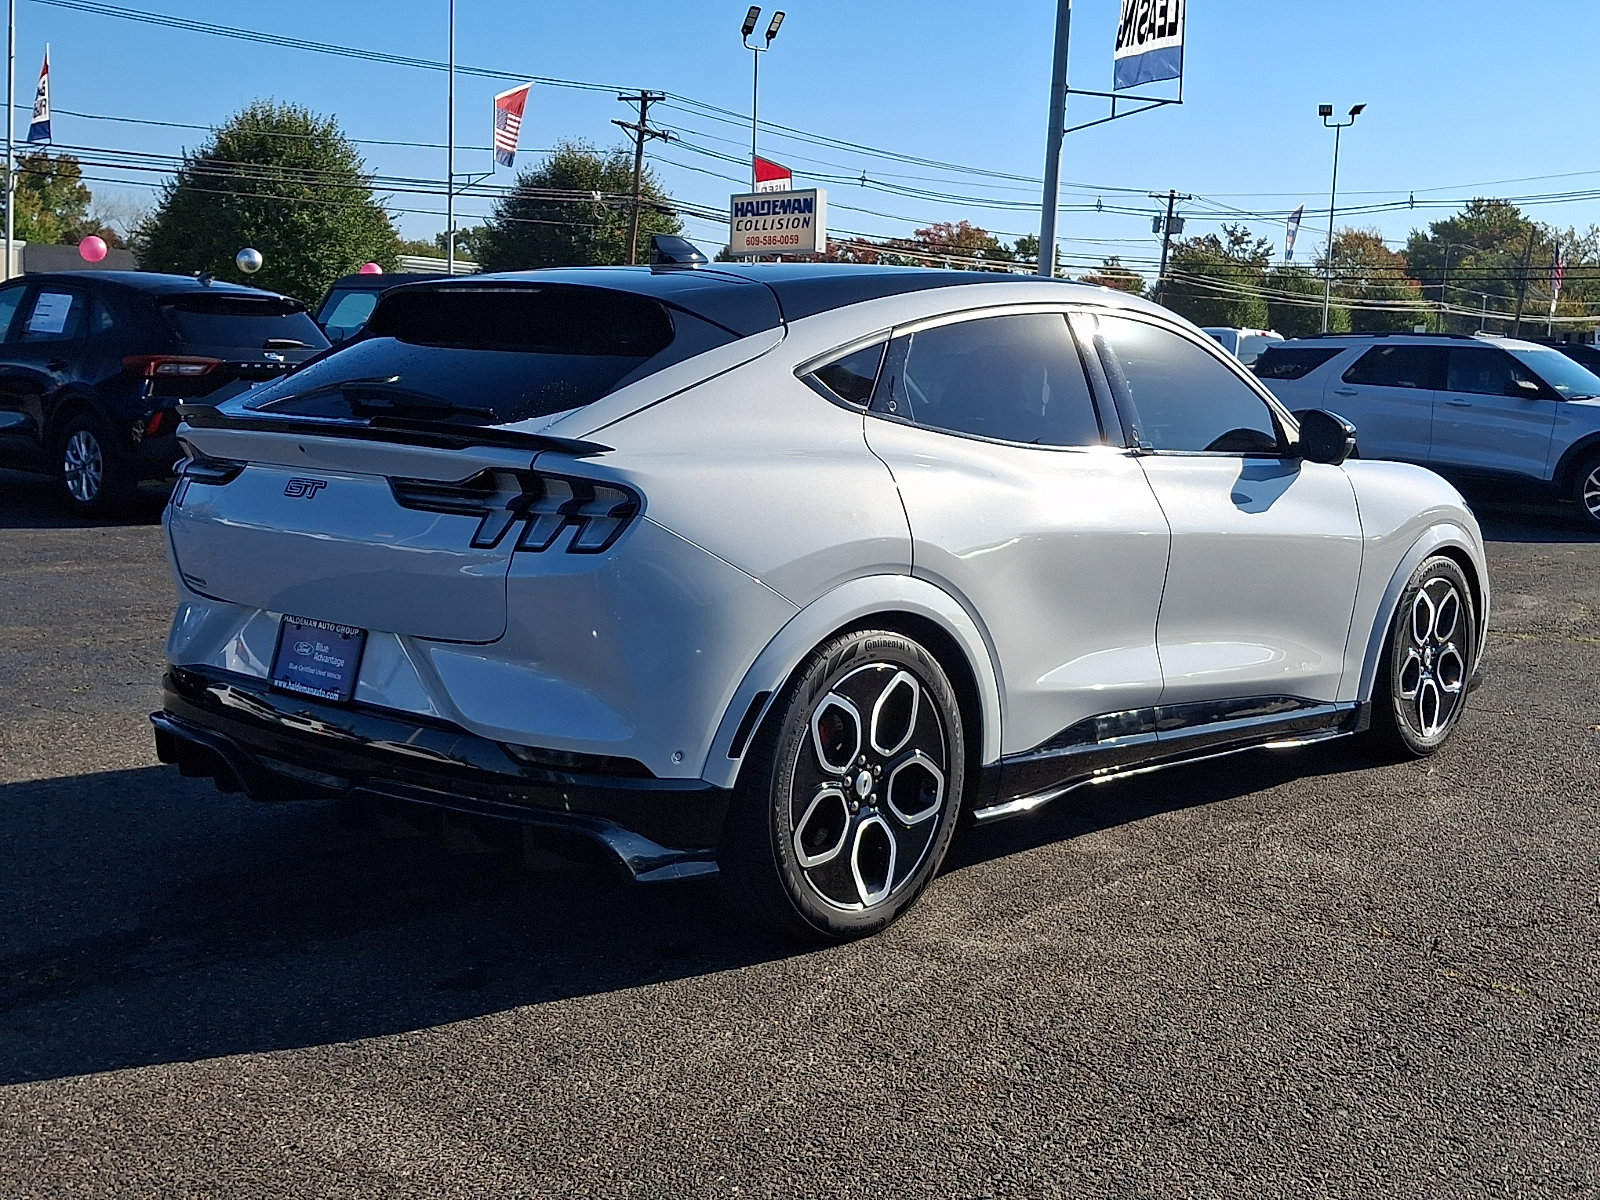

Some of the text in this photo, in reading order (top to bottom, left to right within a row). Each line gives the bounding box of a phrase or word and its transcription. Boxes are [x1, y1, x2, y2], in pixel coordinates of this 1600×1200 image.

[734, 197, 813, 217] HALDEMAN
[736, 216, 811, 232] COLLISION
[745, 234, 799, 246] 609-586-0059
[283, 615, 360, 635] HALDEMAN AUTO GROUP
[296, 642, 311, 654] Ford
[315, 642, 330, 653] Blue
[864, 637, 905, 652] Continental
[313, 652, 345, 668] Advantage
[273, 679, 339, 700] www.haldemanauto.com
